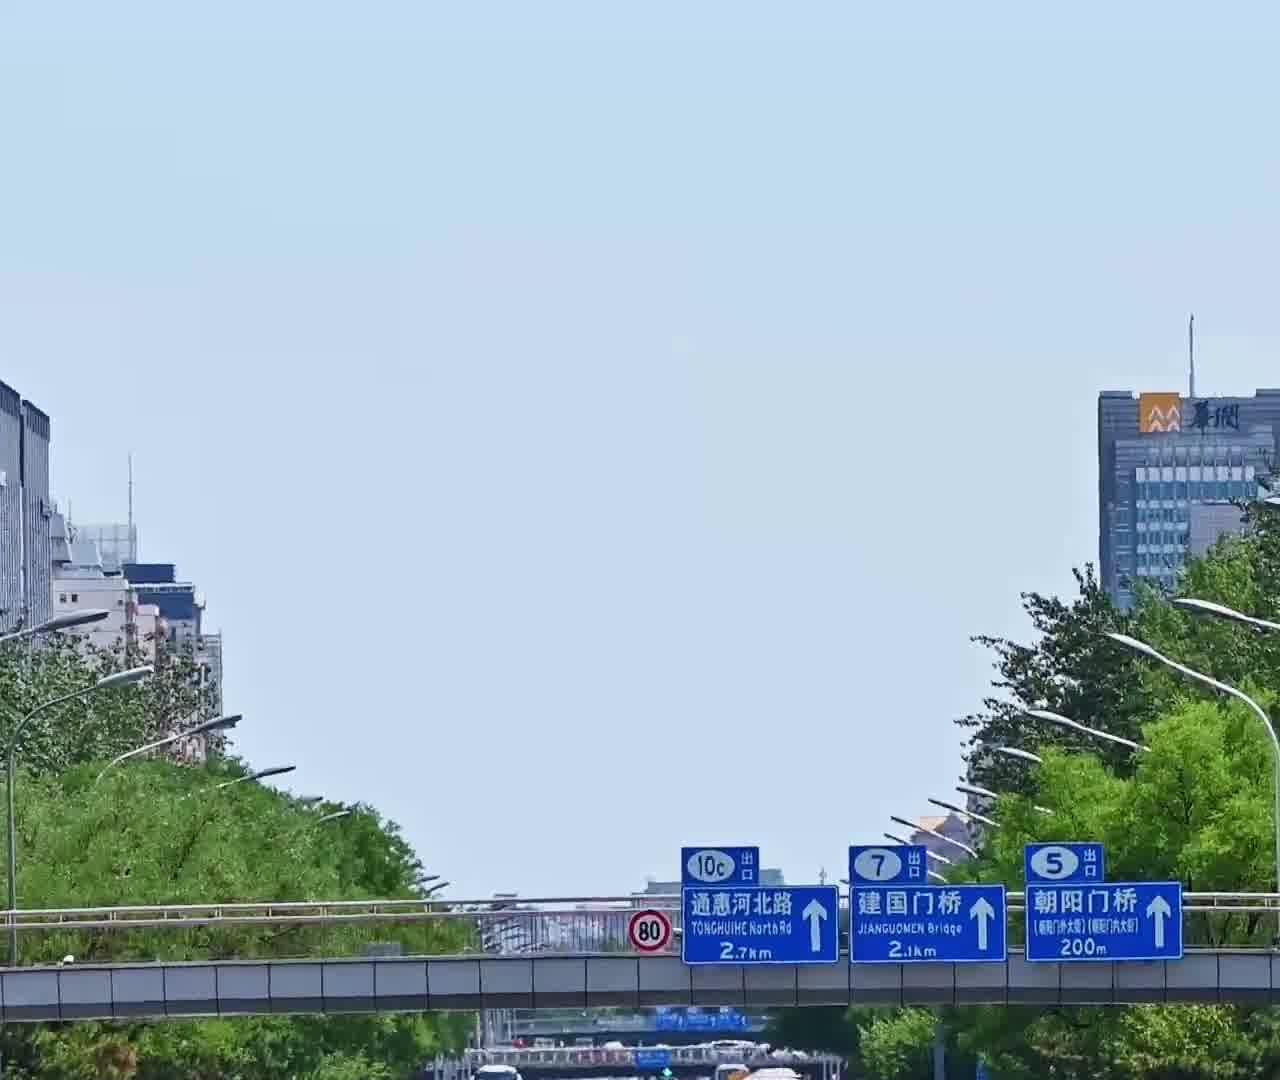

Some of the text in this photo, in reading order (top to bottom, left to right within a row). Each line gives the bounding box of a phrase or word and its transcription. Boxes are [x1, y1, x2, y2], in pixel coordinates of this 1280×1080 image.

[741, 852, 753, 880] 出口
[871, 855, 885, 877] 7
[908, 851, 920, 878] 出口
[1046, 853, 1063, 875] 5
[1084, 849, 1096, 877] 出口
[691, 891, 793, 916] 通惠河北路
[858, 890, 962, 916] 建国门桥
[1034, 888, 1138, 914] 朝阳门桥
[638, 920, 661, 942] 80
[691, 920, 792, 936] TONGHUIHE North Rd
[857, 922, 963, 937] JIANGUOMEN Bridge
